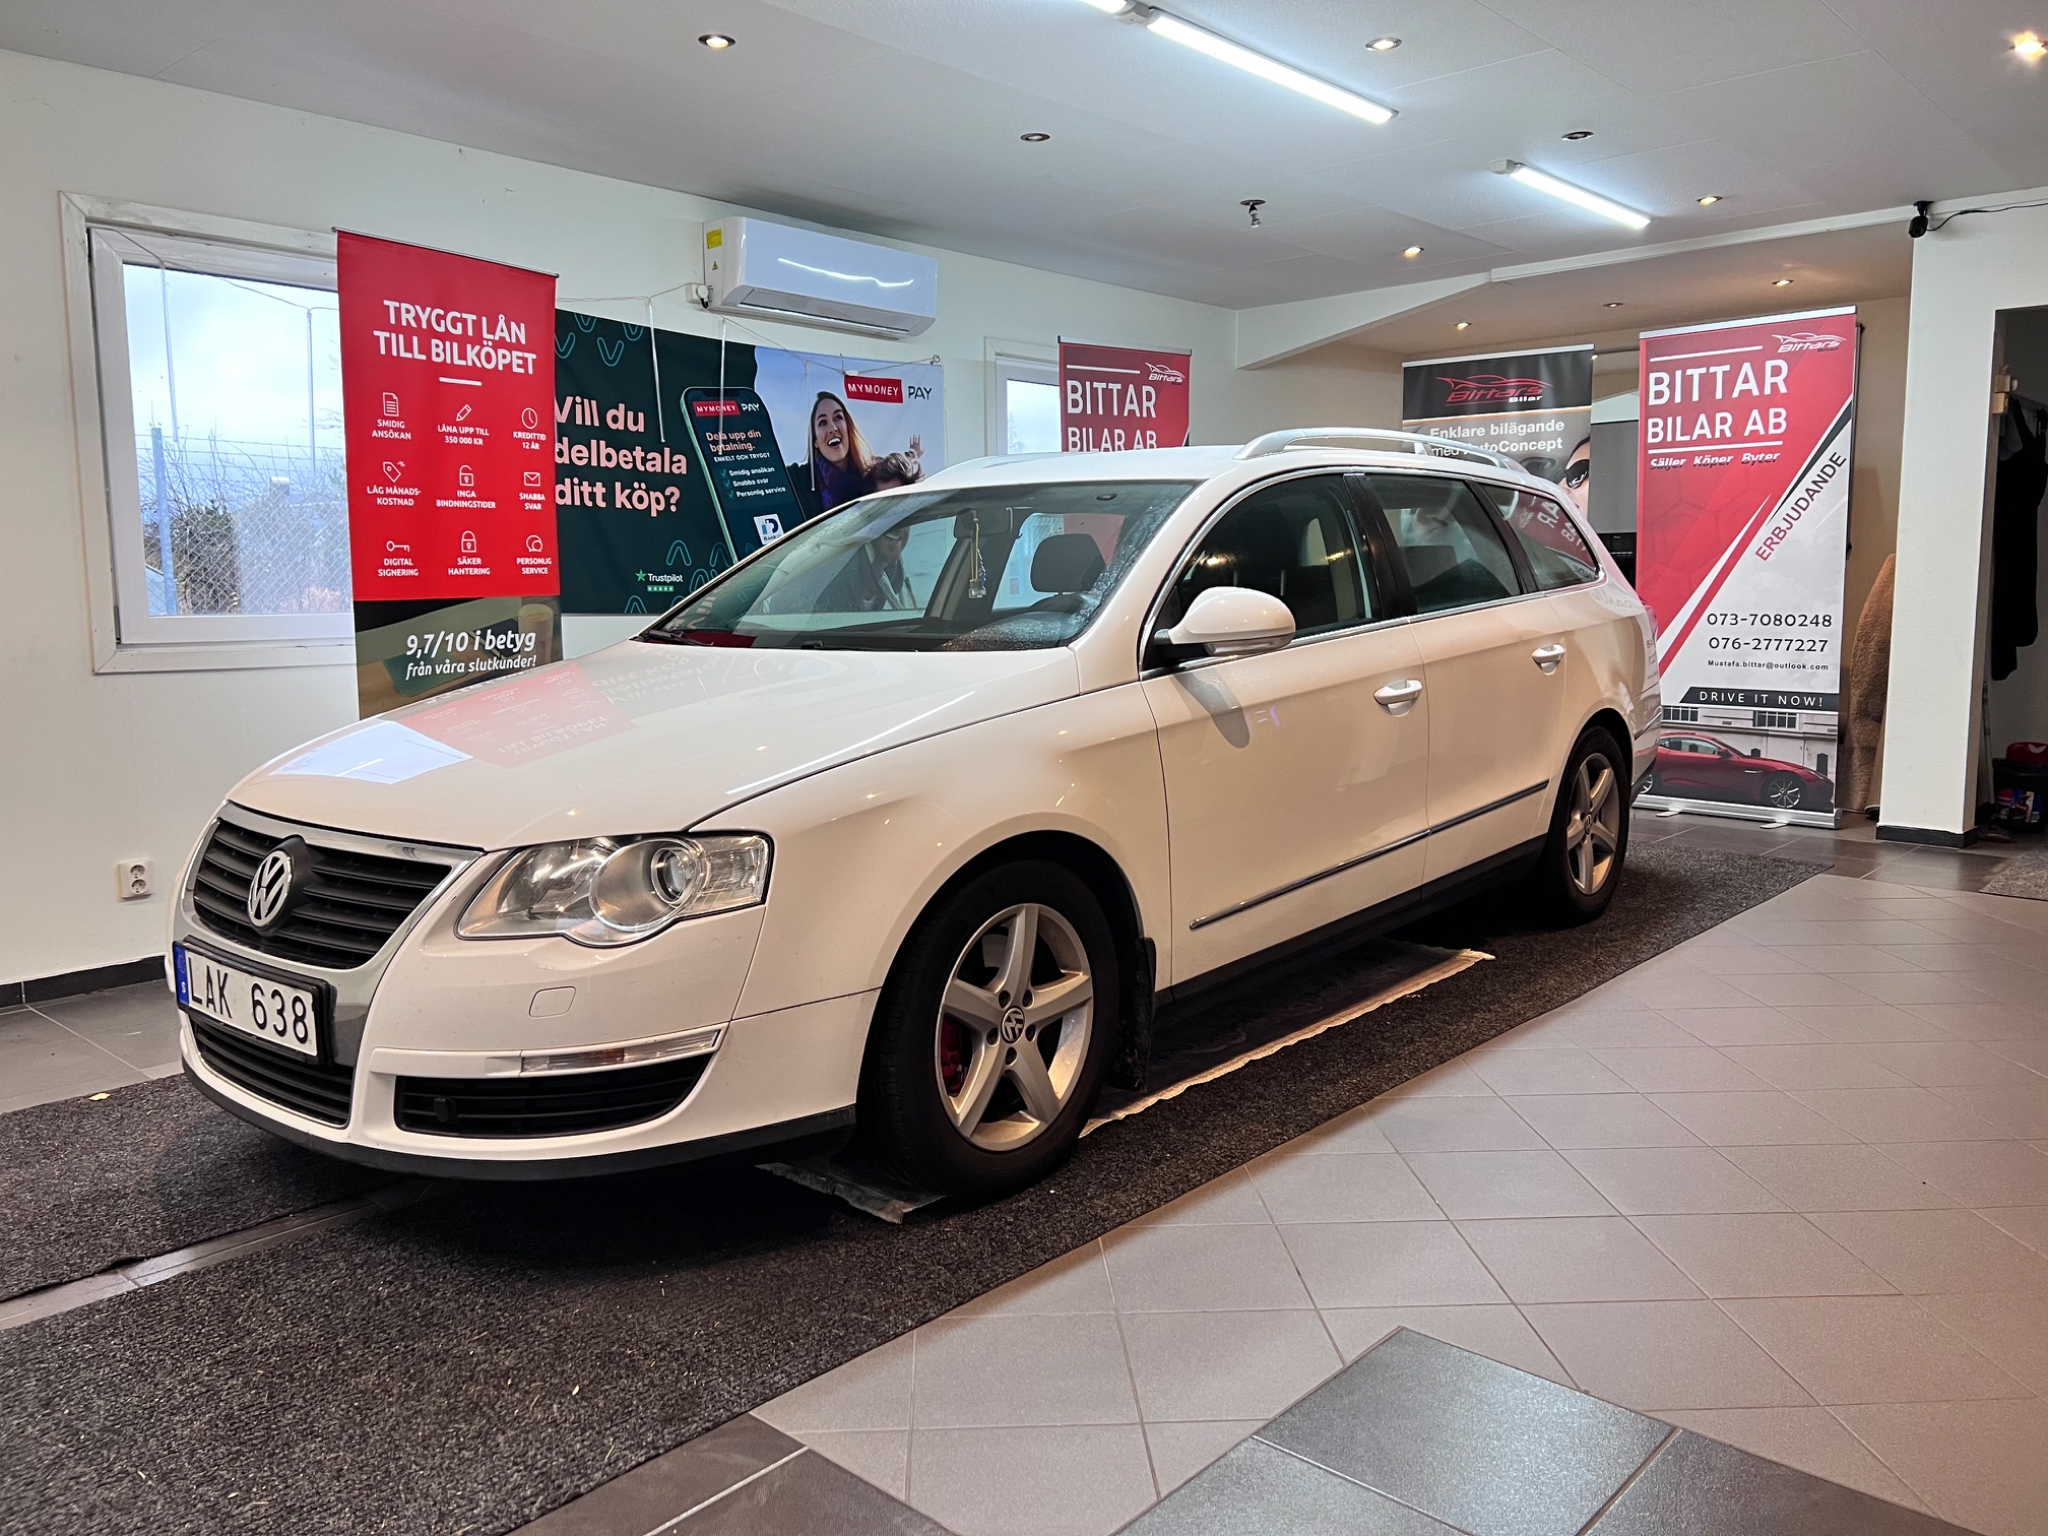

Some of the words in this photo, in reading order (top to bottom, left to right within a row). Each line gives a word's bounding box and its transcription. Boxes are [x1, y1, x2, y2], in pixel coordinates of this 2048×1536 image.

[383, 299, 477, 336] TRYGGT
[482, 314, 526, 345] LÅN
[373, 330, 426, 360] TILL
[431, 341, 537, 374] BILKÖPET
[1648, 359, 1789, 406] BITTAR
[847, 383, 899, 396] MYMONEY
[908, 385, 933, 400] PAY
[1066, 380, 1157, 418] BITTAR
[696, 405, 736, 413] MYMONEY
[741, 403, 759, 412] PAY
[554, 396, 600, 427] Vill
[606, 403, 645, 432] du
[377, 418, 405, 429] SMIDIG
[1430, 426, 1486, 439] Enklare
[1490, 419, 1565, 436] bilägande
[1647, 412, 1733, 444] BILAR
[1743, 407, 1788, 436] AB
[371, 428, 411, 440] ANSÖKAN
[437, 423, 458, 434] LÅNA
[459, 426, 474, 435] UPP
[475, 427, 489, 436] TILL
[444, 435, 458, 444] 350
[459, 436, 472, 445] 000
[473, 437, 483, 445] KR
[513, 431, 546, 441] KREDITTID
[728, 432, 746, 441] upp
[747, 430, 762, 438] din
[1067, 427, 1125, 452] BILAR
[1133, 429, 1157, 450] AB
[522, 441, 530, 449] 12
[530, 440, 540, 450] ÅR
[555, 437, 687, 474] delbetala
[729, 469, 750, 477] Smidig
[367, 485, 384, 494] LÅG
[386, 486, 421, 496] MÅNADS-
[457, 490, 476, 498] INGA
[377, 497, 414, 506] KOSTNAD
[519, 493, 546, 501] SNABBA
[555, 477, 606, 508] ditt
[615, 482, 680, 517] köp?
[436, 500, 496, 509] BINDNINGSTIDER
[1754, 451, 1847, 562] ERBJUDANDE
[384, 558, 413, 566] DIGITAL
[457, 556, 482, 565] SÄKER
[516, 557, 552, 565] PERSONLIG
[377, 568, 419, 577] SIGNERING
[448, 567, 491, 575] HANTERING
[521, 567, 549, 575] SERVICE
[647, 573, 683, 583] Trustpilot
[1707, 613, 1832, 627] 073-7080248
[406, 631, 469, 658] 9,7/10
[473, 630, 481, 650] i
[485, 629, 536, 652] betyg
[1709, 637, 1828, 652] 076-2777227
[405, 662, 432, 680] från
[435, 659, 465, 676] våra
[468, 655, 537, 672] slutkunder!
[1708, 660, 1829, 671] Mustafa.bittar@outlook.com
[1700, 691, 1745, 703] DRIVE
[1754, 694, 1769, 704] IT
[1778, 695, 1823, 707] NOW!
[188, 957, 233, 1019] LAK
[251, 983, 309, 1044] 638
